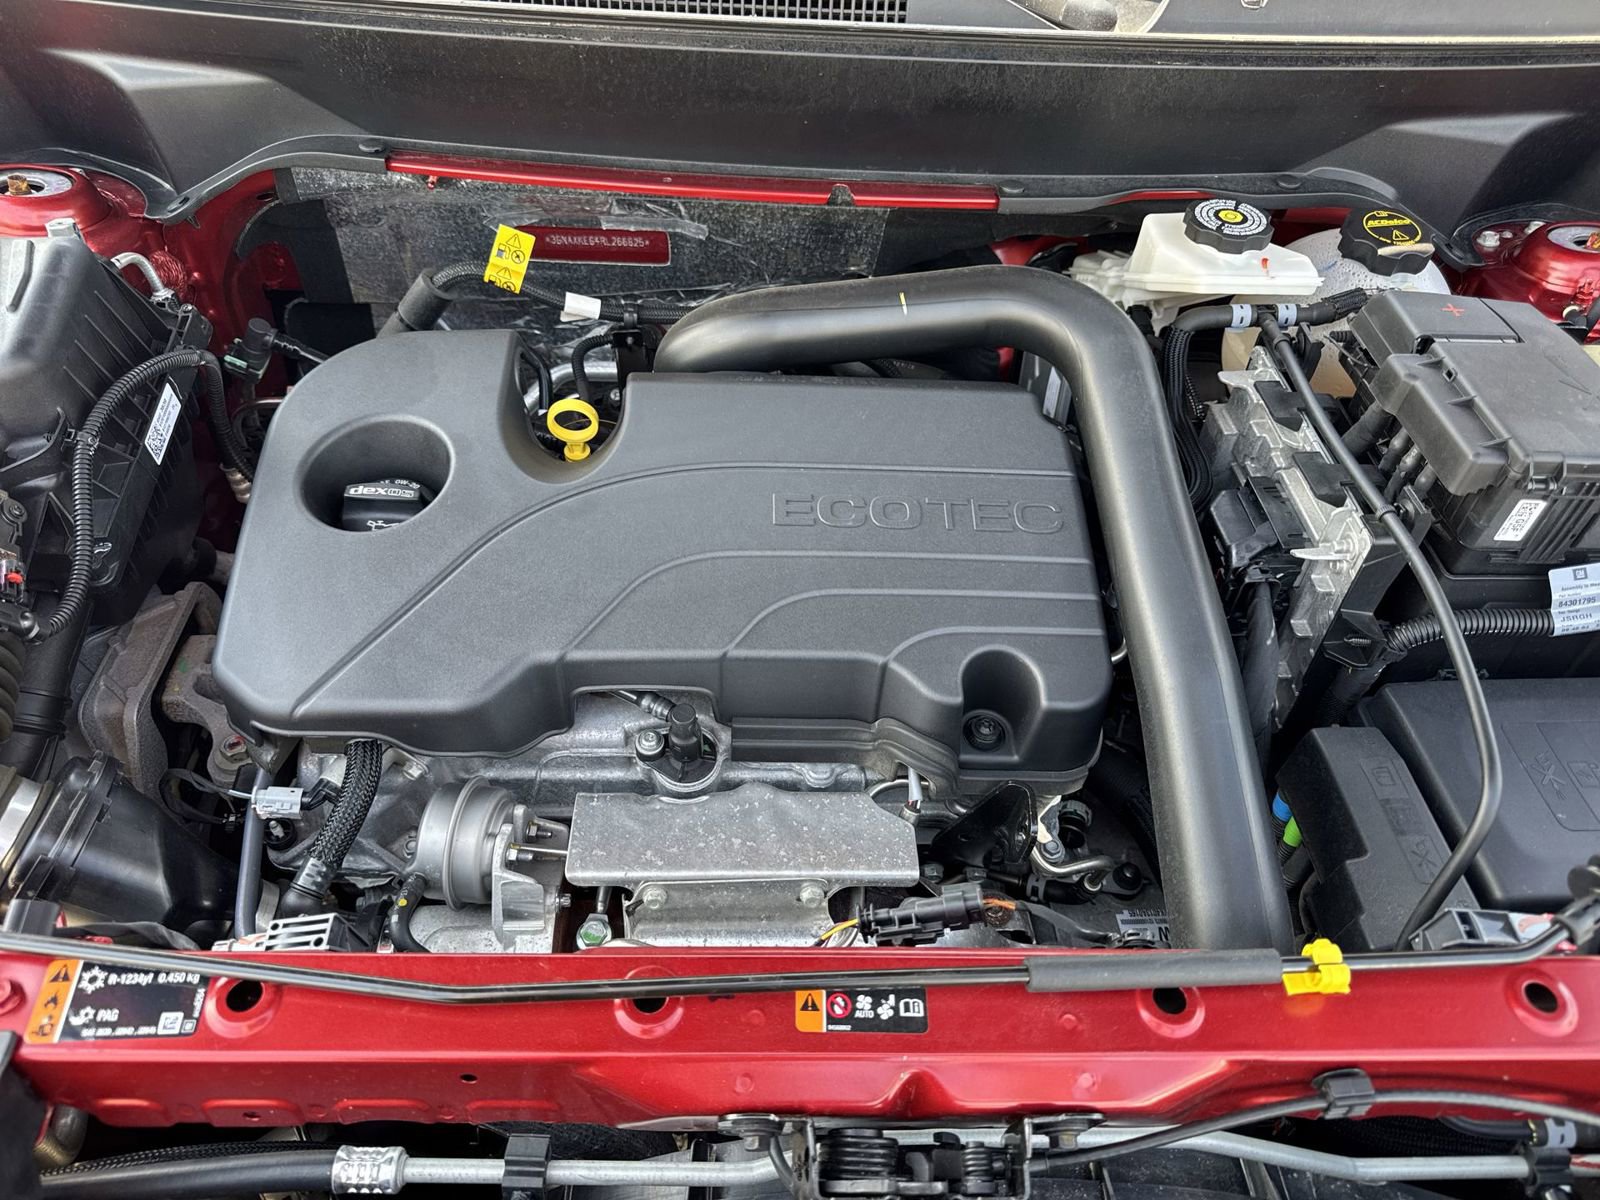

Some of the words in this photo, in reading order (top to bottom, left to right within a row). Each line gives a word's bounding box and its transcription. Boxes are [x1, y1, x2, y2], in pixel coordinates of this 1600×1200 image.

[771, 493, 1065, 534] ECOTEC
[157, 972, 186, 984] 0.450
[186, 972, 200, 985] kg
[96, 1008, 119, 1022] PAG
[854, 1010, 874, 1018] AUTO
